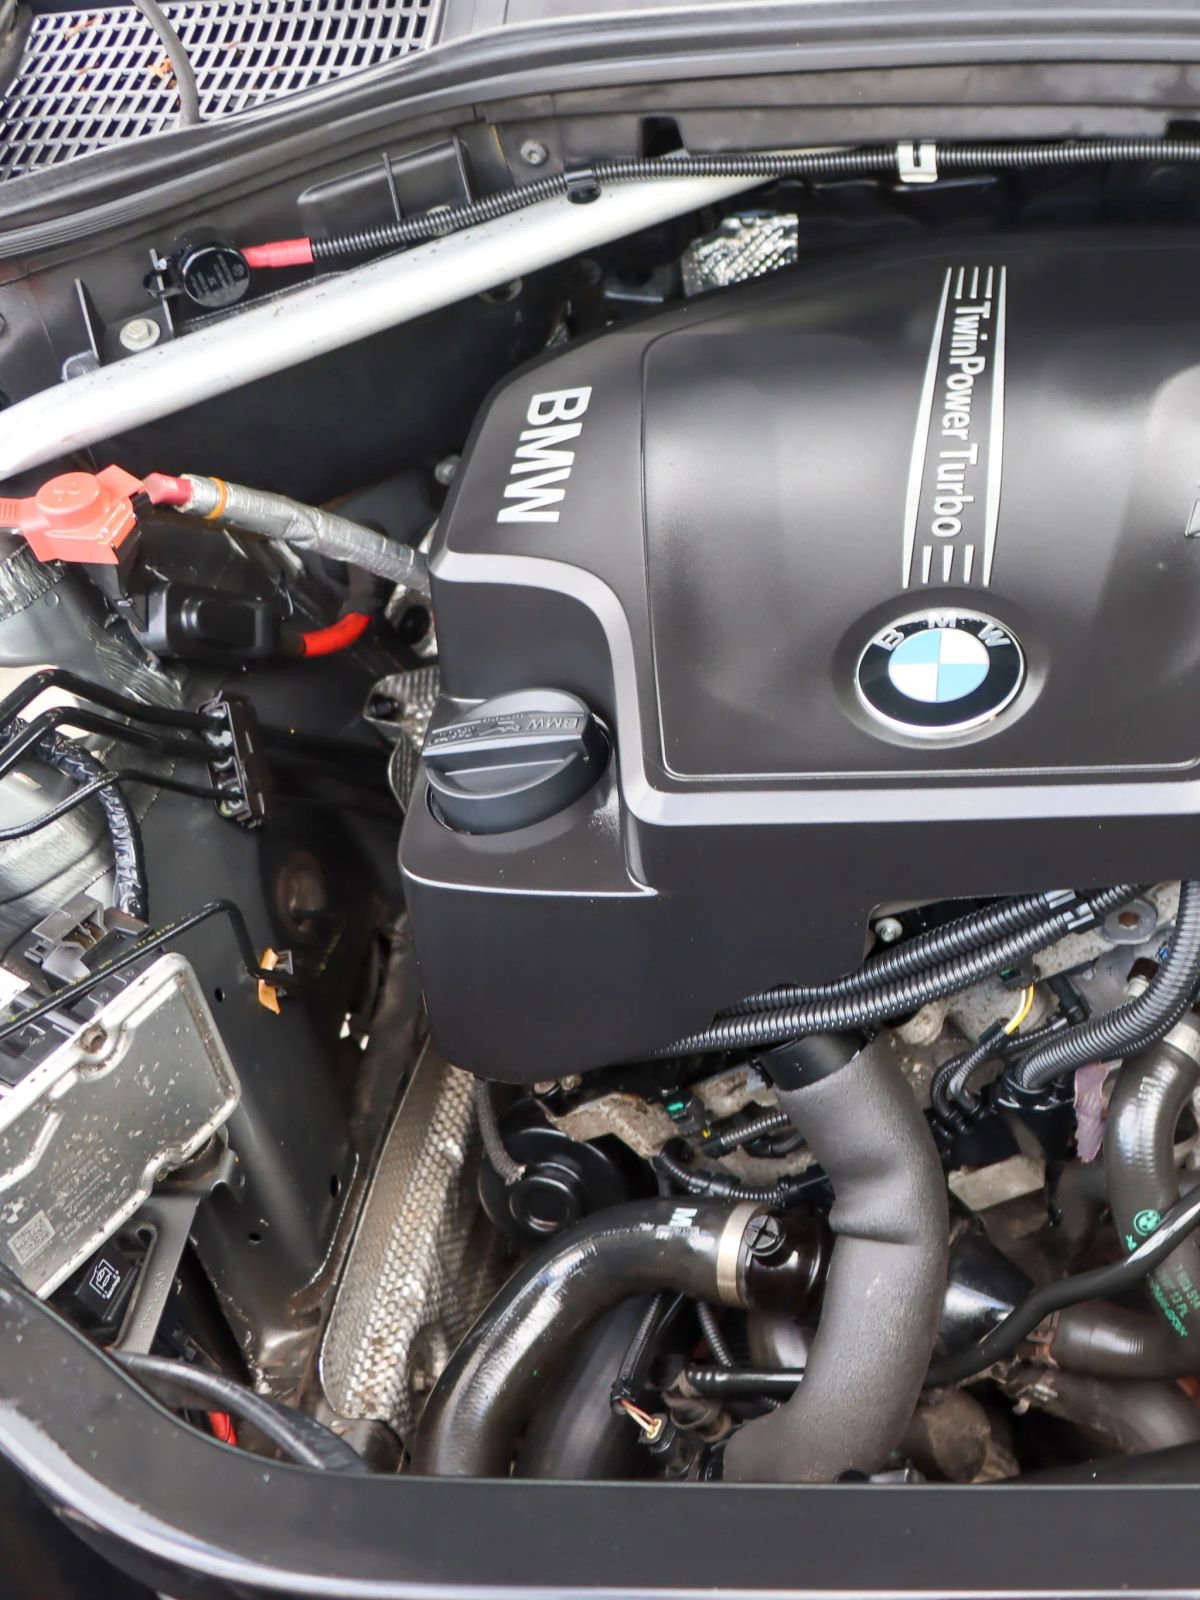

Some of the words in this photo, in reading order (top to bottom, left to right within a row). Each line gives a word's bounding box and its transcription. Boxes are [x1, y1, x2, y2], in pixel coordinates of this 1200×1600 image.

[942, 301, 990, 440] TwinPower
[497, 386, 592, 523] BMW
[931, 443, 978, 538] Turbo
[873, 611, 1011, 651] BMW
[525, 717, 580, 731] BMW
